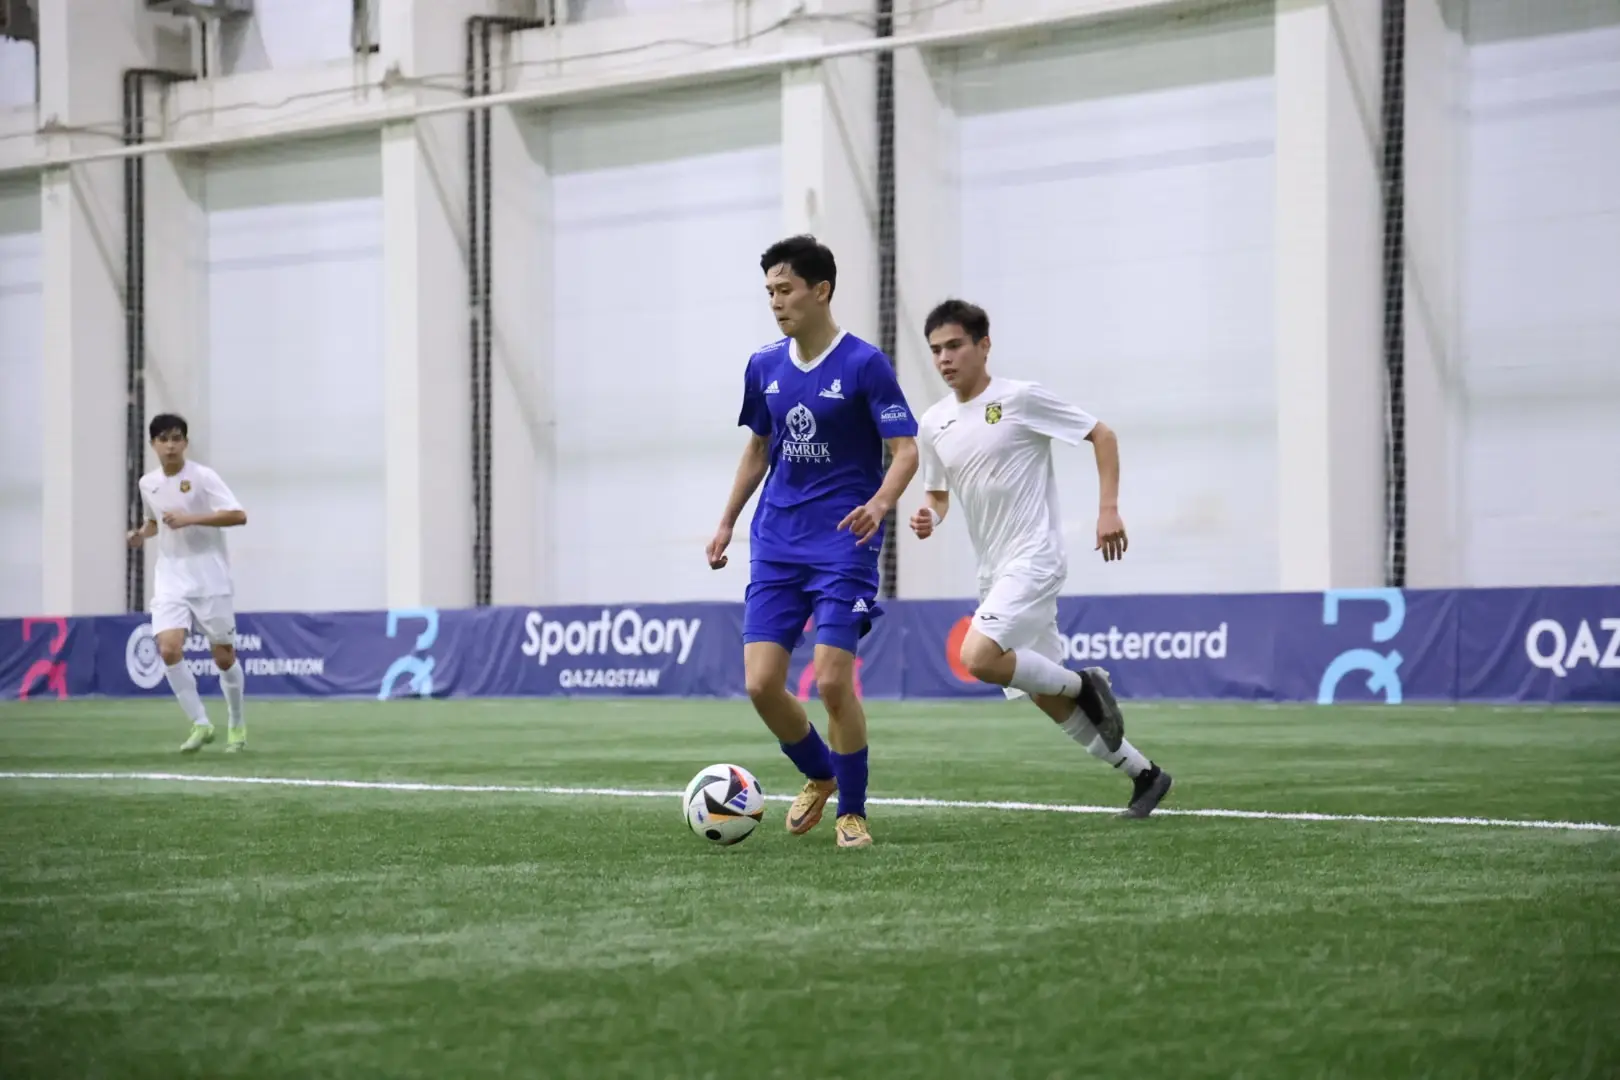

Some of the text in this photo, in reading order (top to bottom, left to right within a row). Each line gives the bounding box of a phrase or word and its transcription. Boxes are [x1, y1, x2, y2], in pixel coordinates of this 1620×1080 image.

[521, 609, 701, 666] SportQory
[245, 658, 325, 675] FEDERATION
[559, 669, 661, 688] QAZAQSTAN
